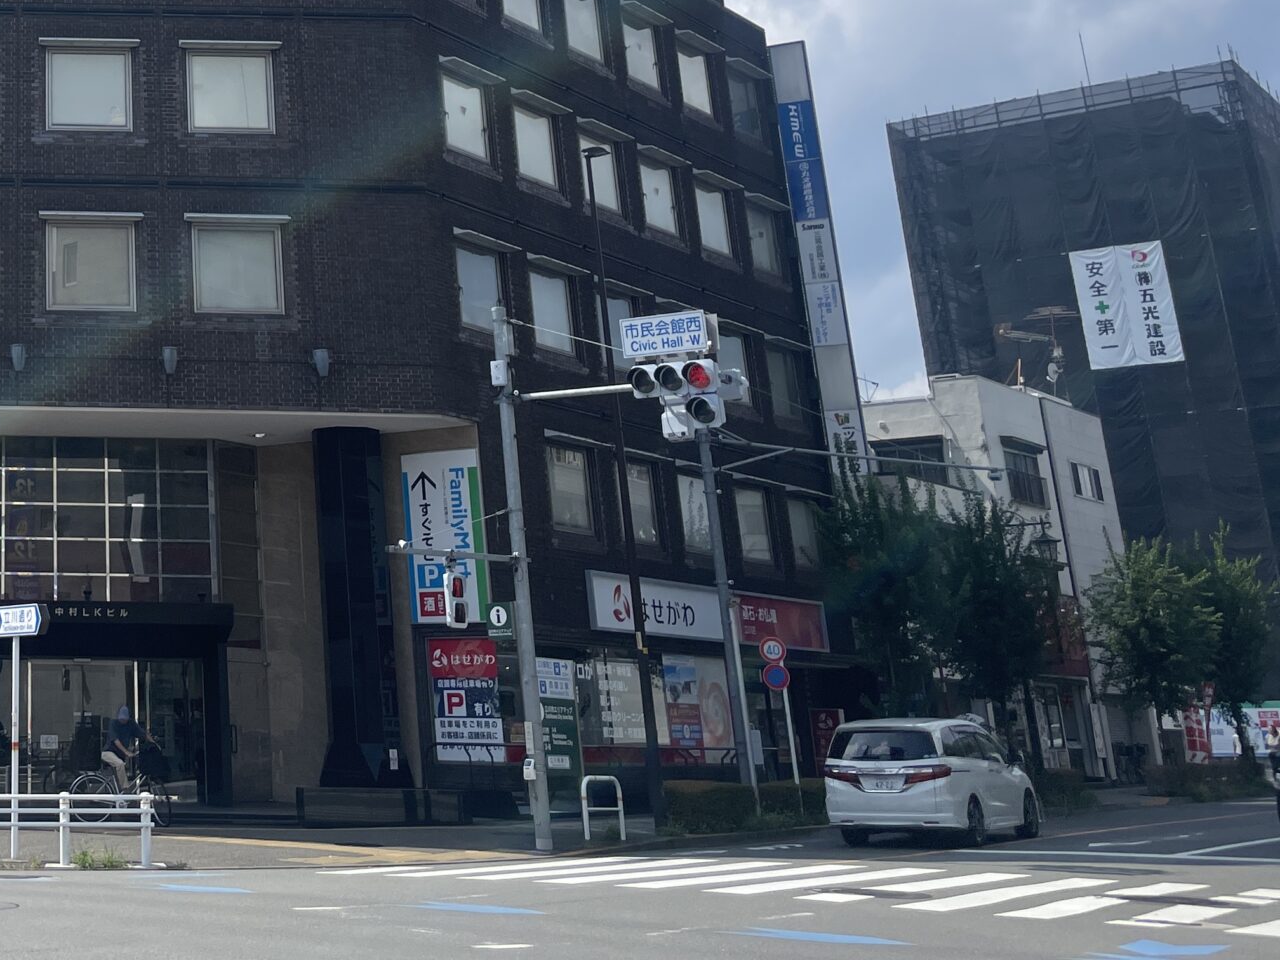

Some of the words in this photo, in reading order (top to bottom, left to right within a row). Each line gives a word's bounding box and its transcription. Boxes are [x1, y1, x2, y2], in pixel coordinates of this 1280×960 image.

[624, 316, 701, 339] 市民会館西
[630, 340, 658, 353] Civic
[661, 337, 684, 349] Hall
[449, 467, 471, 579] FamilyMrt
[54, 607, 129, 618] 中村LKビル
[767, 644, 780, 656] 40
[450, 654, 496, 665] はせがわ
[446, 692, 464, 715] P
[473, 702, 492, 717] 有り
